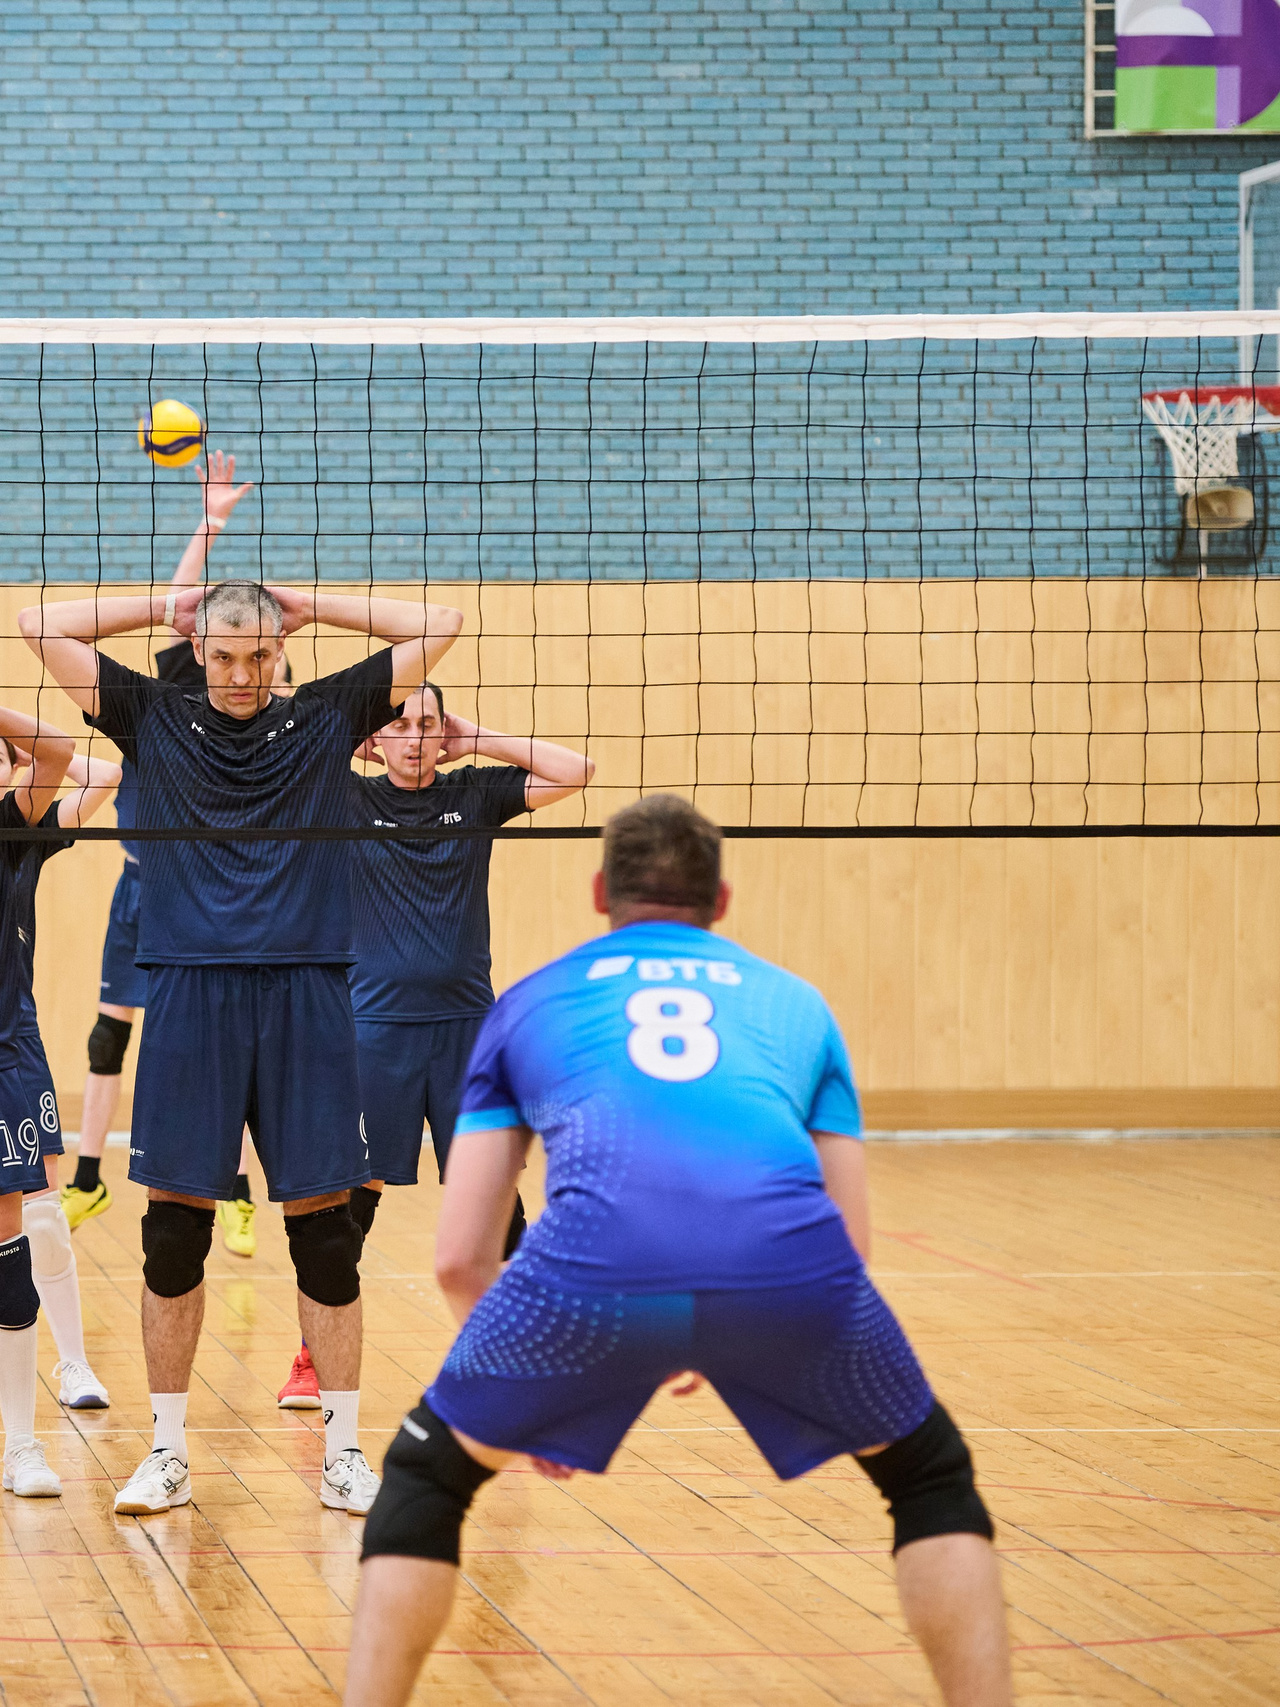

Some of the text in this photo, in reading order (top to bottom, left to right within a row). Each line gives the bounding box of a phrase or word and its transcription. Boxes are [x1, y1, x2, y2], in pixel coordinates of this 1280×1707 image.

[443, 811, 462, 825] ВТБ
[637, 957, 743, 987] ВТБ
[625, 986, 720, 1082] 8
[39, 1090, 59, 1134] 8
